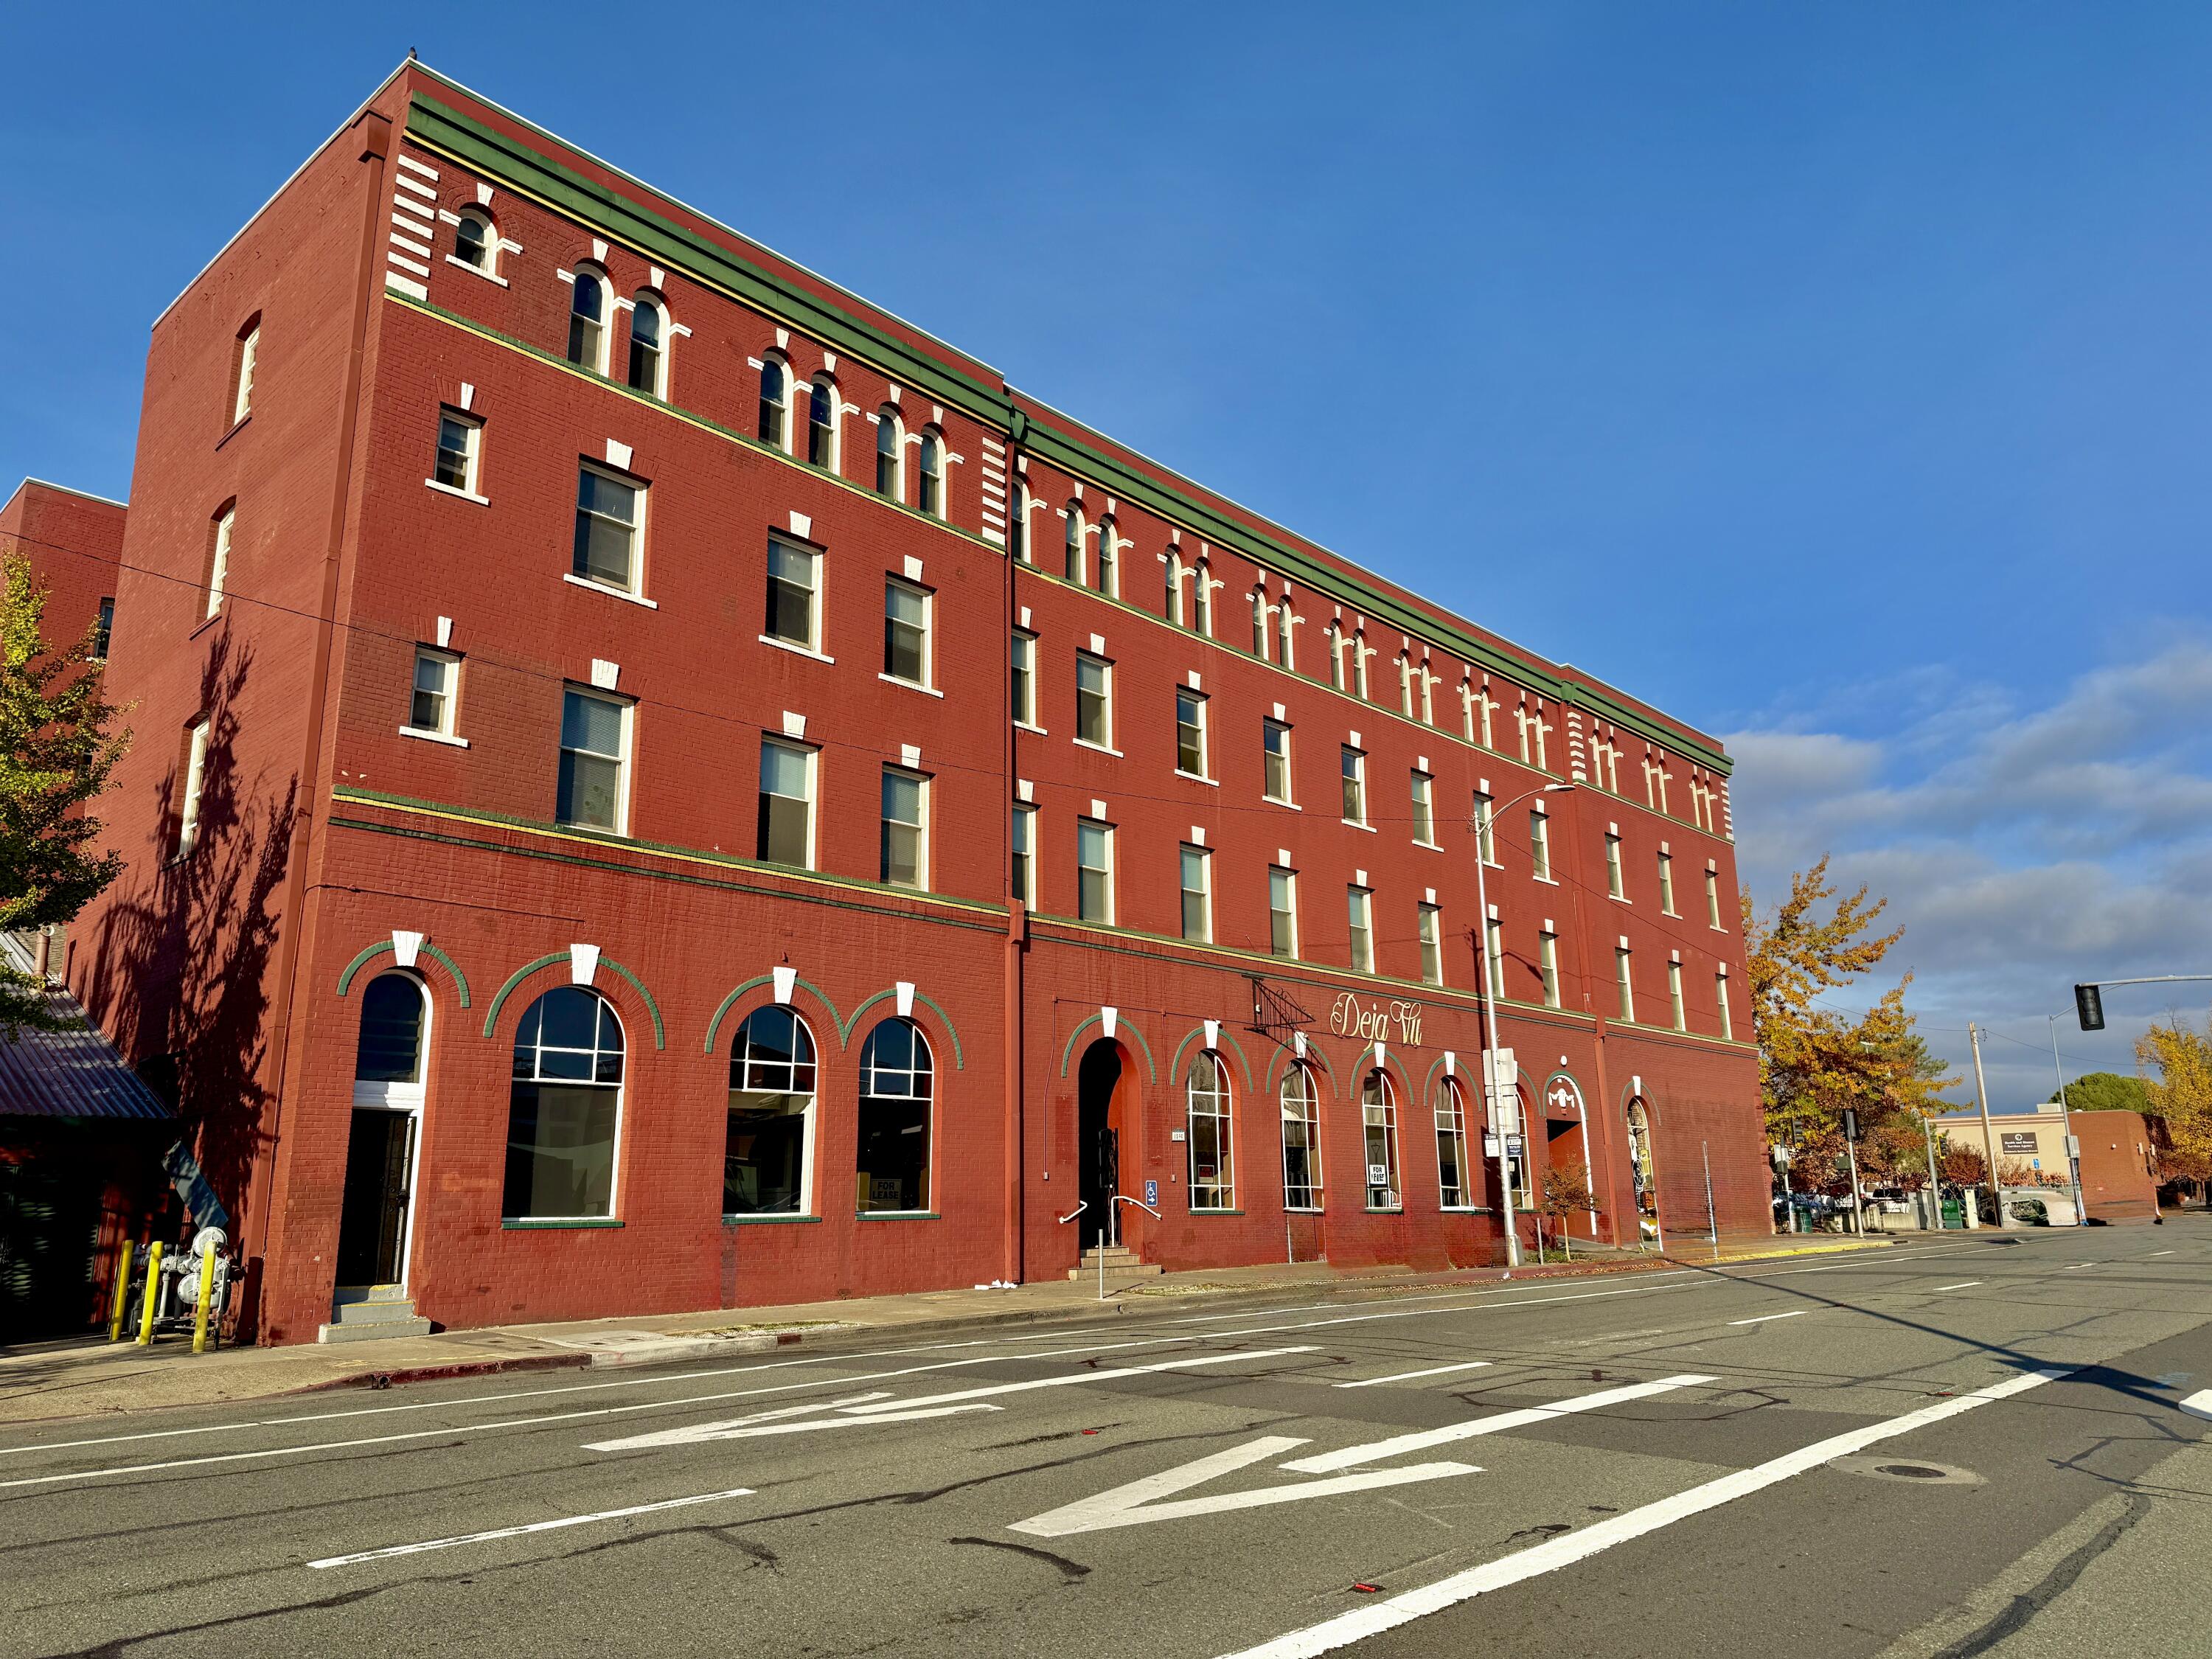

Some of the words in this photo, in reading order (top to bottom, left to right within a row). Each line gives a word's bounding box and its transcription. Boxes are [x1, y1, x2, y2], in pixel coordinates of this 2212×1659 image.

[1330, 992, 1389, 1051] Deja
[1390, 1001, 1422, 1046] Vu
[878, 1182, 894, 1190] FOR
[873, 1191, 899, 1199] LEASE
